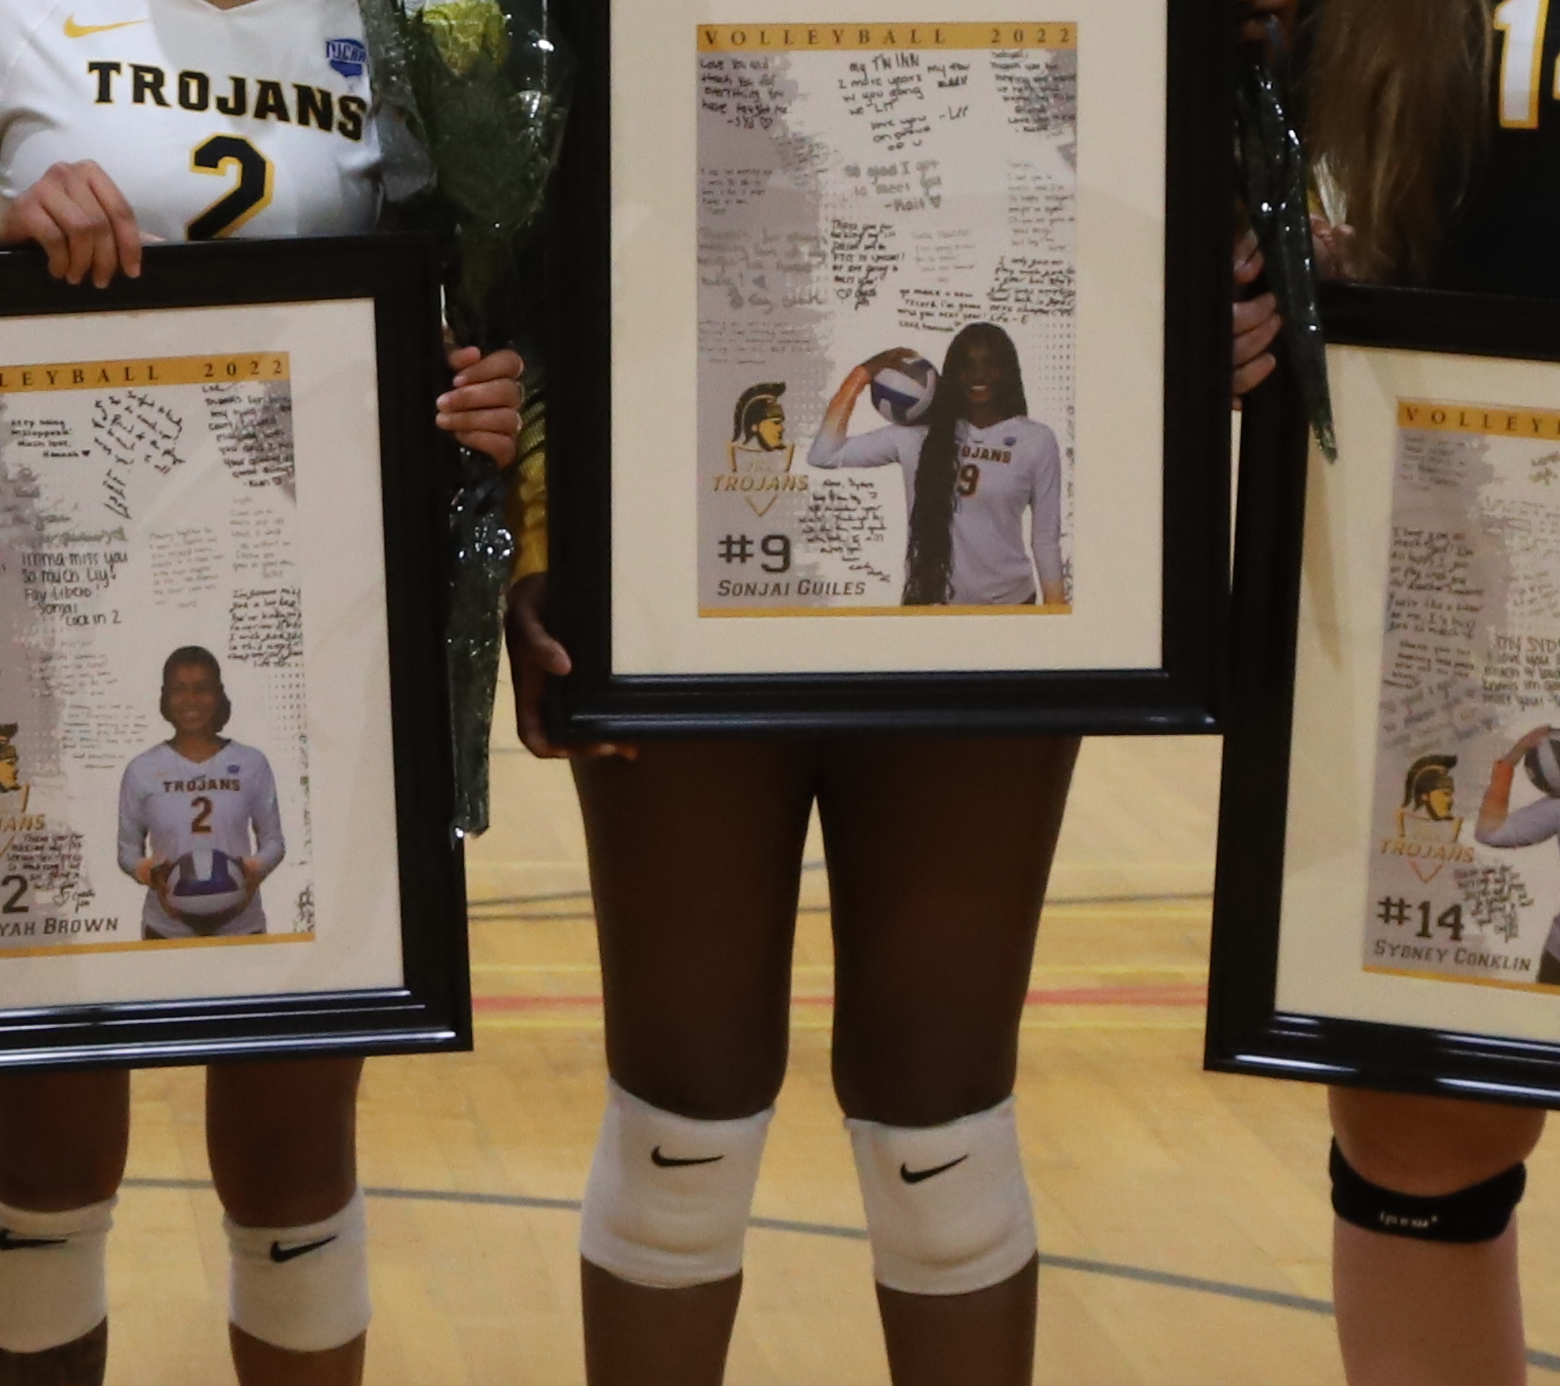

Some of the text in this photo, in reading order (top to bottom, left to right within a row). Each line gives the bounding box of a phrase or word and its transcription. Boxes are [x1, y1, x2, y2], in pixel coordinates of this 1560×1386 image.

[704, 28, 1070, 46] VOLLEYBALL 2022
[87, 59, 370, 143] TROJANS
[185, 131, 275, 242] 2
[203, 360, 282, 378] 2022
[712, 474, 809, 492] TROJANS
[957, 463, 981, 496] 9
[718, 534, 792, 573] #9
[162, 777, 242, 794] TROJANS
[190, 796, 213, 835] 2
[1380, 838, 1475, 863] TROJANS
[1376, 895, 1465, 942] #14
